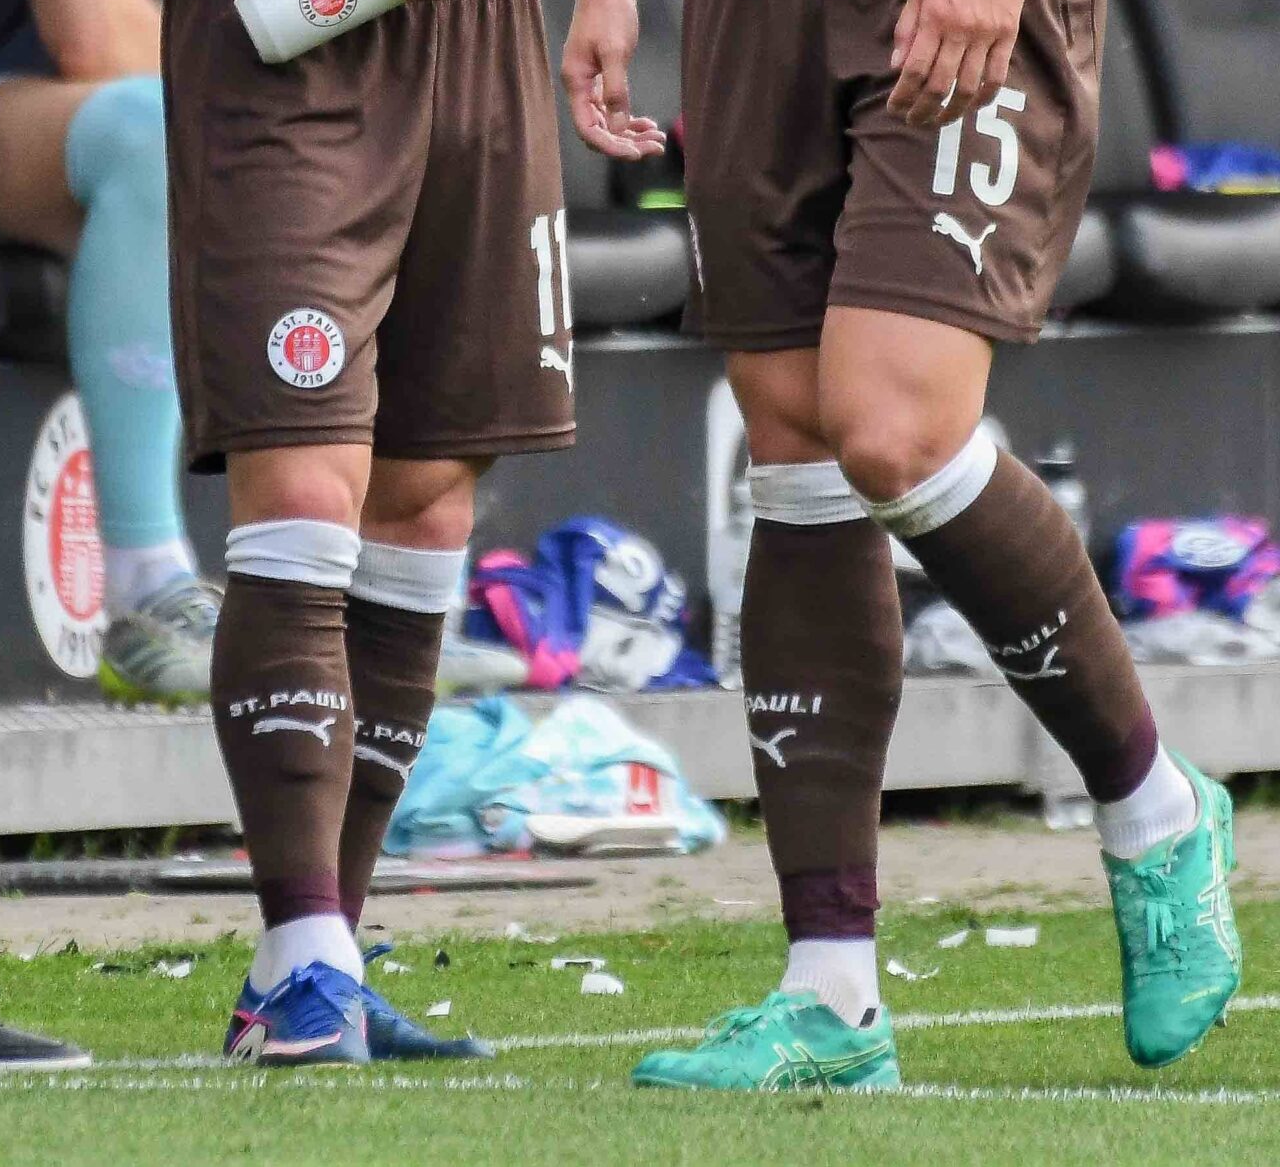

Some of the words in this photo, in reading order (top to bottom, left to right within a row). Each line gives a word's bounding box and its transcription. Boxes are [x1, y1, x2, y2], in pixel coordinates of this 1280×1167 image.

[302, 0, 317, 21] 1910
[932, 85, 1026, 206] 15
[531, 209, 571, 336] 11
[271, 332, 283, 347] FC
[307, 313, 340, 347] PAULI
[292, 373, 323, 385] 1910
[270, 690, 348, 711] PAULI
